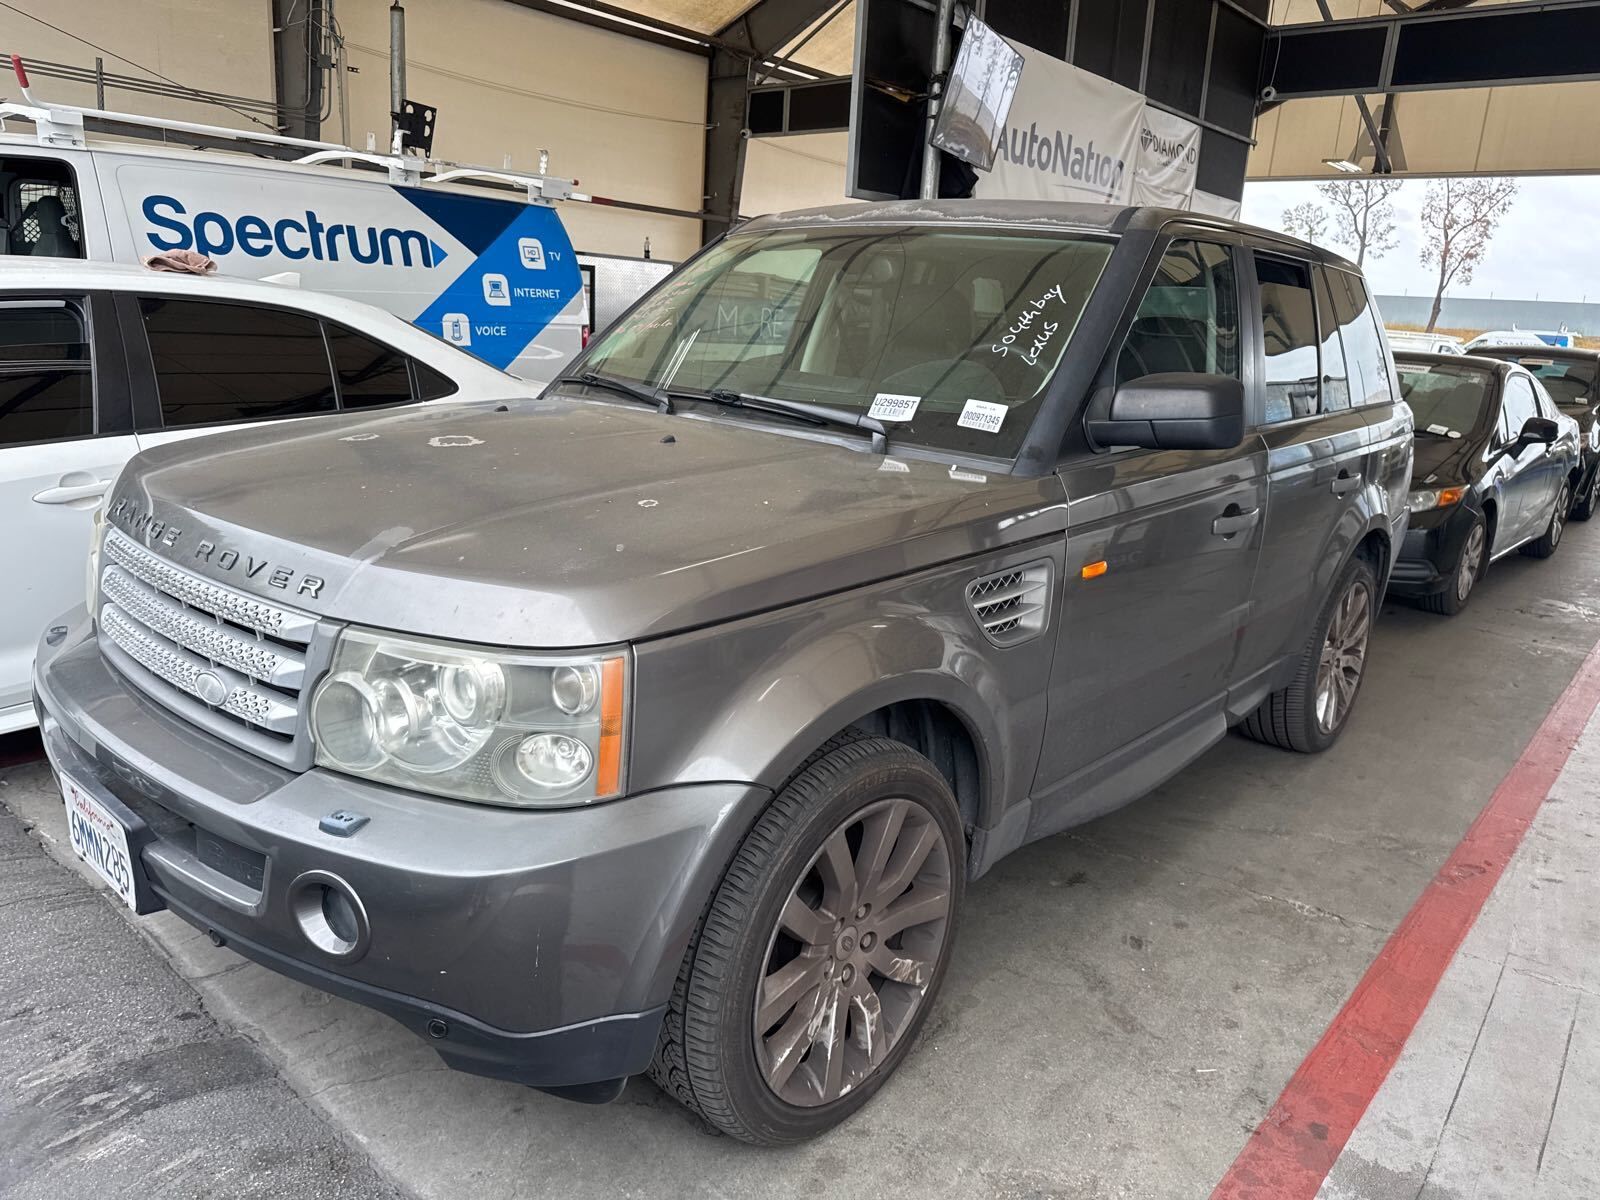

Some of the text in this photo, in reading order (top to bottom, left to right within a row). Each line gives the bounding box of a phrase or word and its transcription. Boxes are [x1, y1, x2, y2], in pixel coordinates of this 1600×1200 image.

[998, 121, 1125, 190] AutoNation
[1153, 134, 1197, 165] DIAMOND
[142, 194, 432, 269] Spectrum
[548, 251, 561, 262] TV
[514, 287, 560, 300] INTERNET
[475, 325, 507, 336] VOICE
[874, 397, 917, 410] U29985T
[113, 498, 325, 600] RANGE ROVER
[71, 809, 130, 893] 6MMN285
